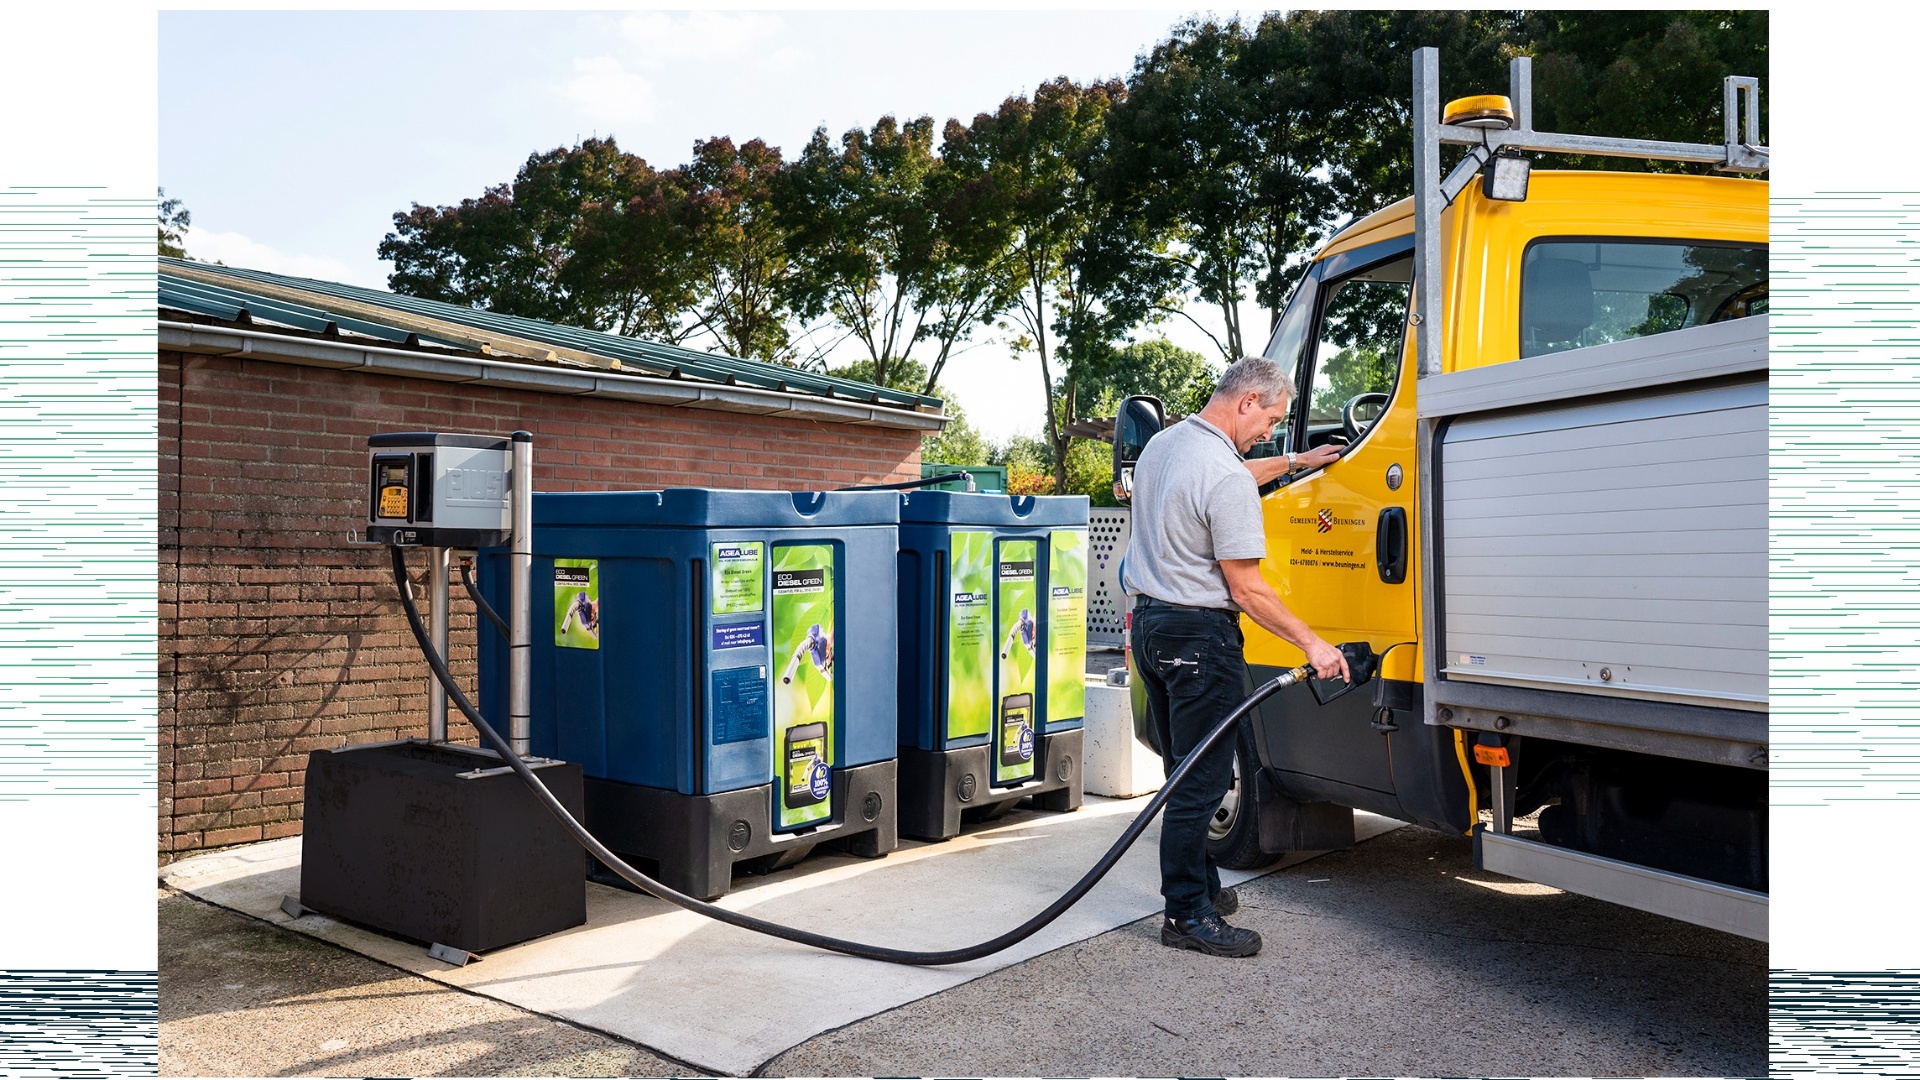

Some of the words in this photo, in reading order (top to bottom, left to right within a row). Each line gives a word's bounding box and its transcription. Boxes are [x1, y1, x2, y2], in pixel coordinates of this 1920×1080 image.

[1289, 516, 1317, 524] GEMEENTE
[1333, 517, 1366, 525] BEUNINGEN
[719, 549, 758, 557] AGEALUBE
[1322, 561, 1366, 570] www.beuningen.nl
[777, 579, 802, 587] DIESEL
[955, 593, 988, 602] AGEALUBE
[814, 778, 829, 788] 100%
